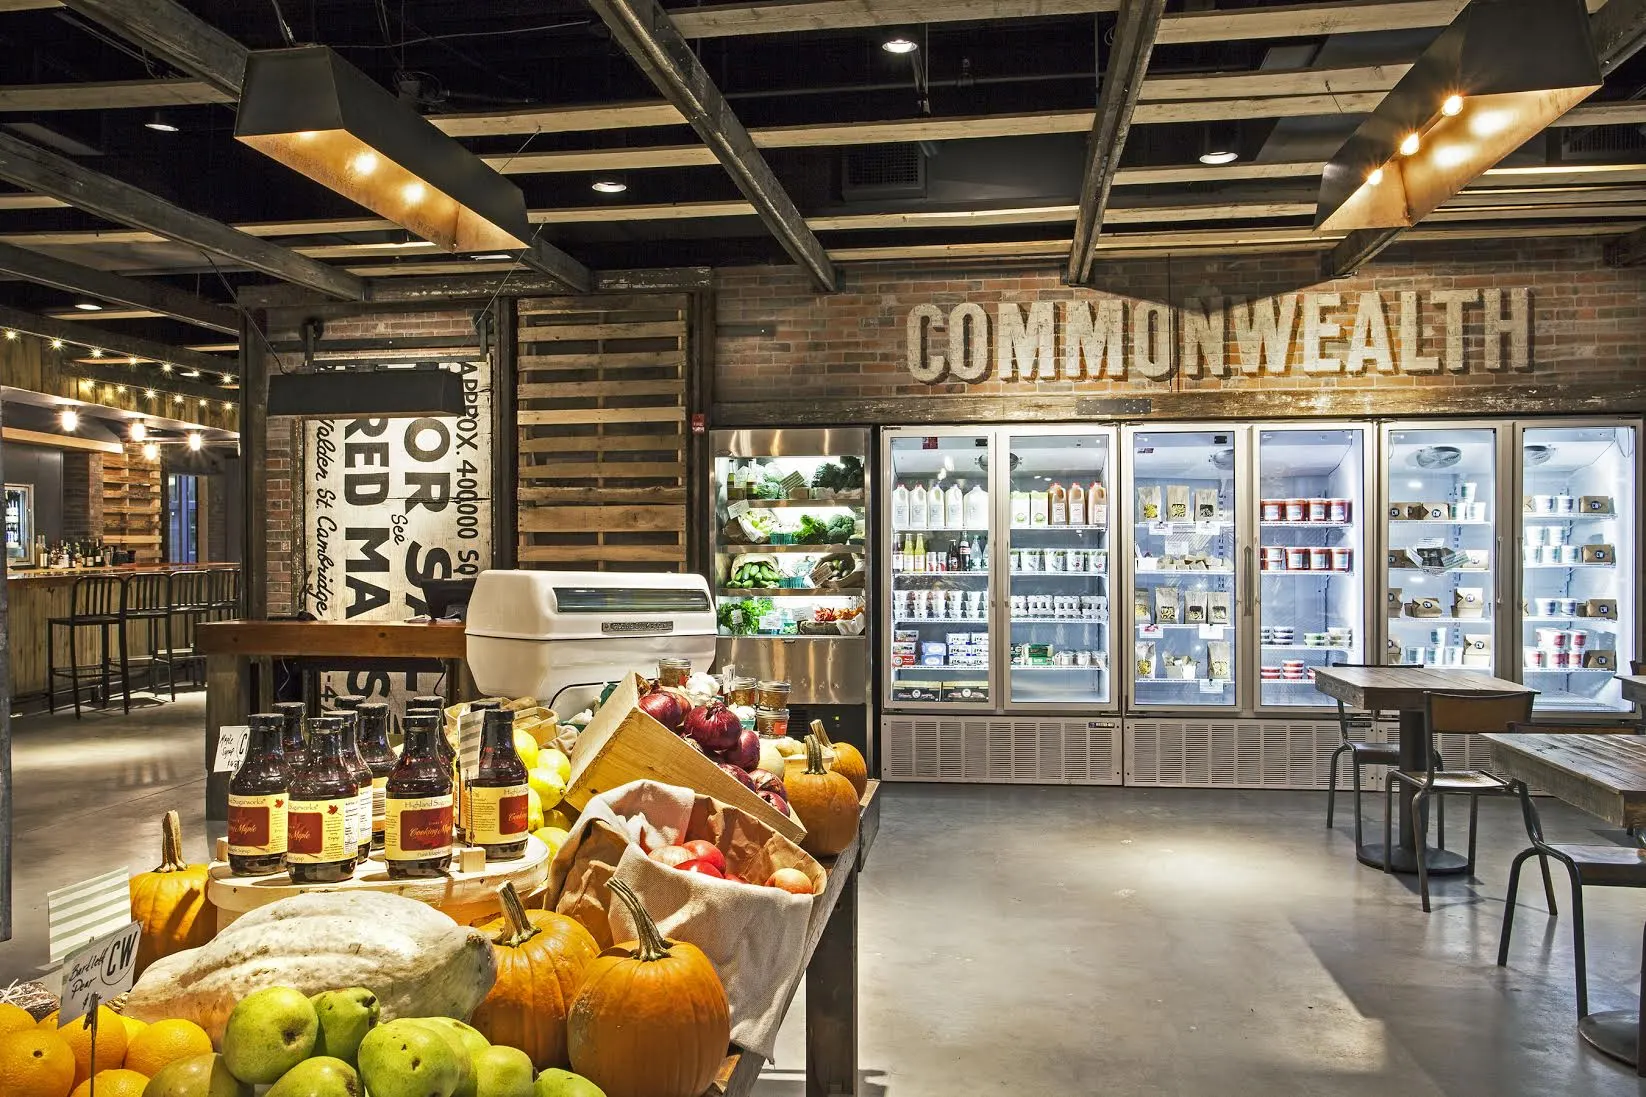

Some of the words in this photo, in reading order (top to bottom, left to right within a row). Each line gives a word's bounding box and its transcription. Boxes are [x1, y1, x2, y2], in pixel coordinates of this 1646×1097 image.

[905, 288, 1533, 384] COMMONWEALTH
[344, 417, 390, 506] RED
[404, 417, 451, 515] OR
[315, 488, 337, 510] St.
[391, 514, 408, 546] See
[307, 516, 338, 616] Cambridge
[107, 930, 138, 977] CW
[72, 976, 97, 1000] Pear
